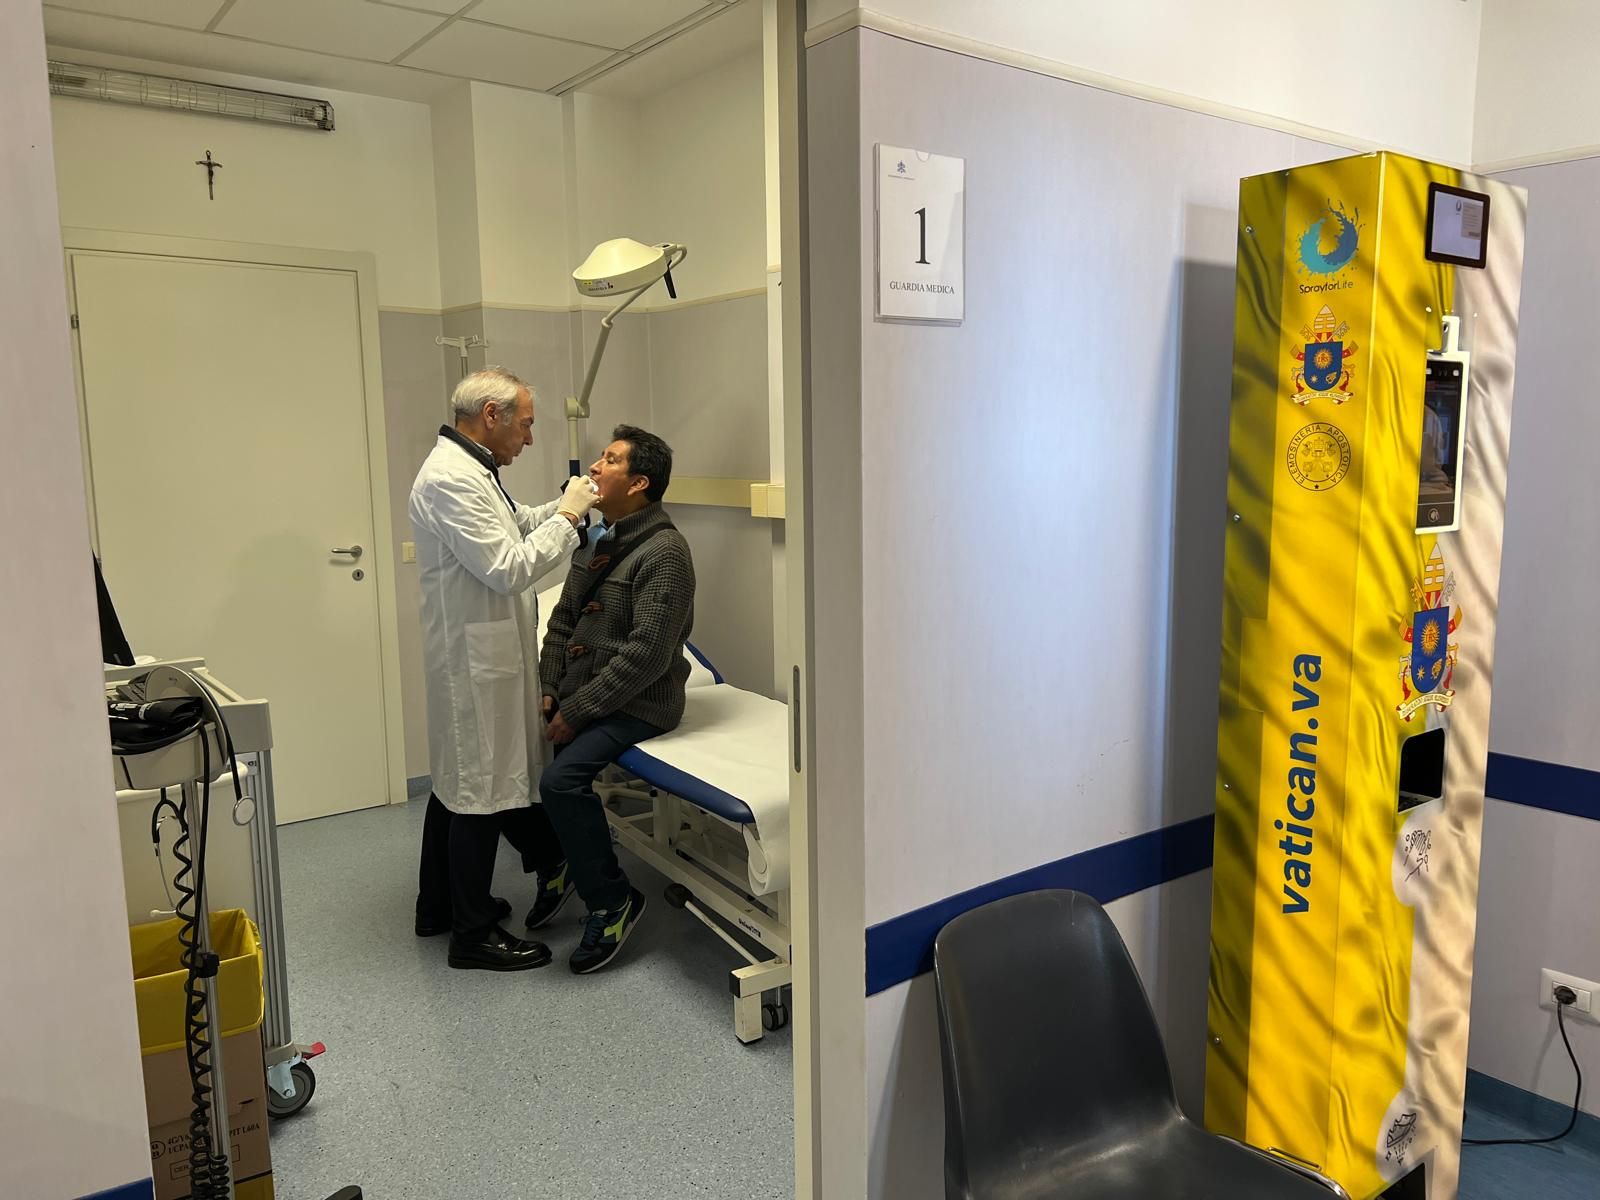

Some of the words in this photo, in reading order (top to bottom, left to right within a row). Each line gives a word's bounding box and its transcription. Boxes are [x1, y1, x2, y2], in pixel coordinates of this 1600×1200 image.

[914, 207, 931, 265] 1
[889, 280, 925, 293] GUARDIA
[926, 283, 955, 295] MEDICA
[1299, 280, 1354, 295] SprayforLife
[1288, 424, 1321, 485] ELEMOSINERIA
[1327, 426, 1349, 484] APOSTOLICA
[1274, 653, 1322, 914] vatican.va
